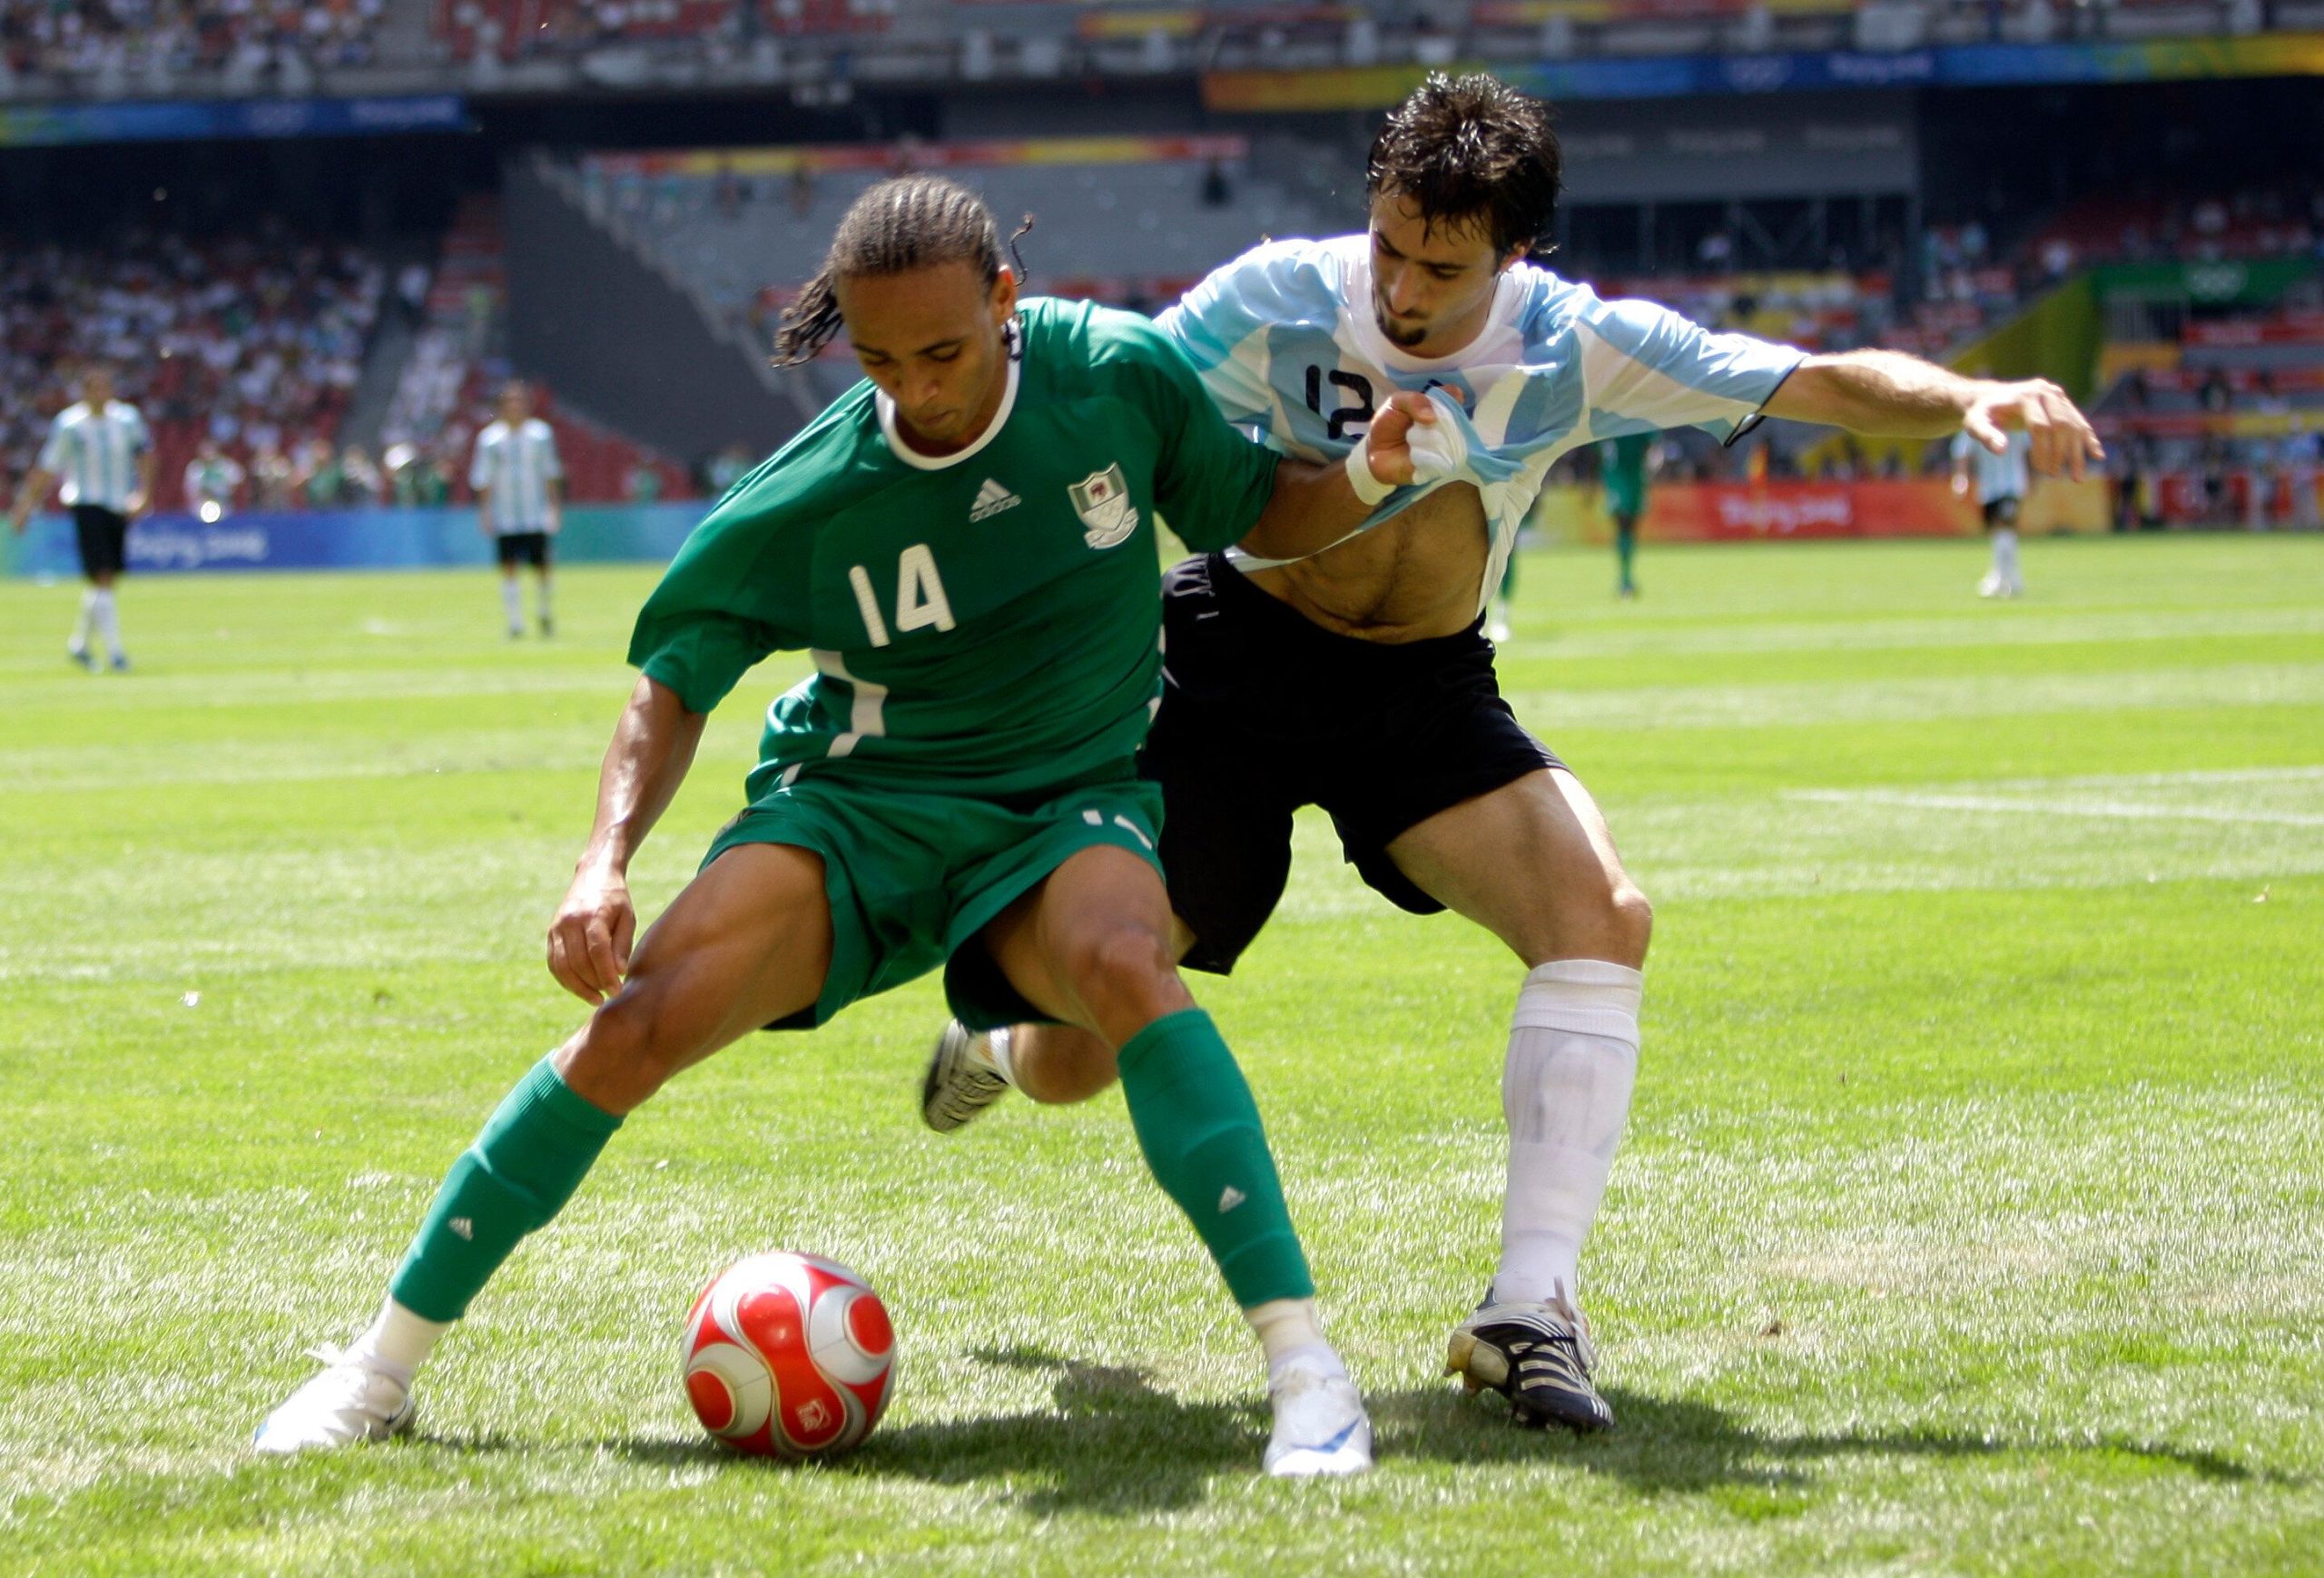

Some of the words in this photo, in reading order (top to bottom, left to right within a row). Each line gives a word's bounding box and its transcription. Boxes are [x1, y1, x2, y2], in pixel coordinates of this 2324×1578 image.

[1305, 365, 1375, 440] 12
[969, 494, 1022, 523] adidas
[848, 543, 957, 647] 14
